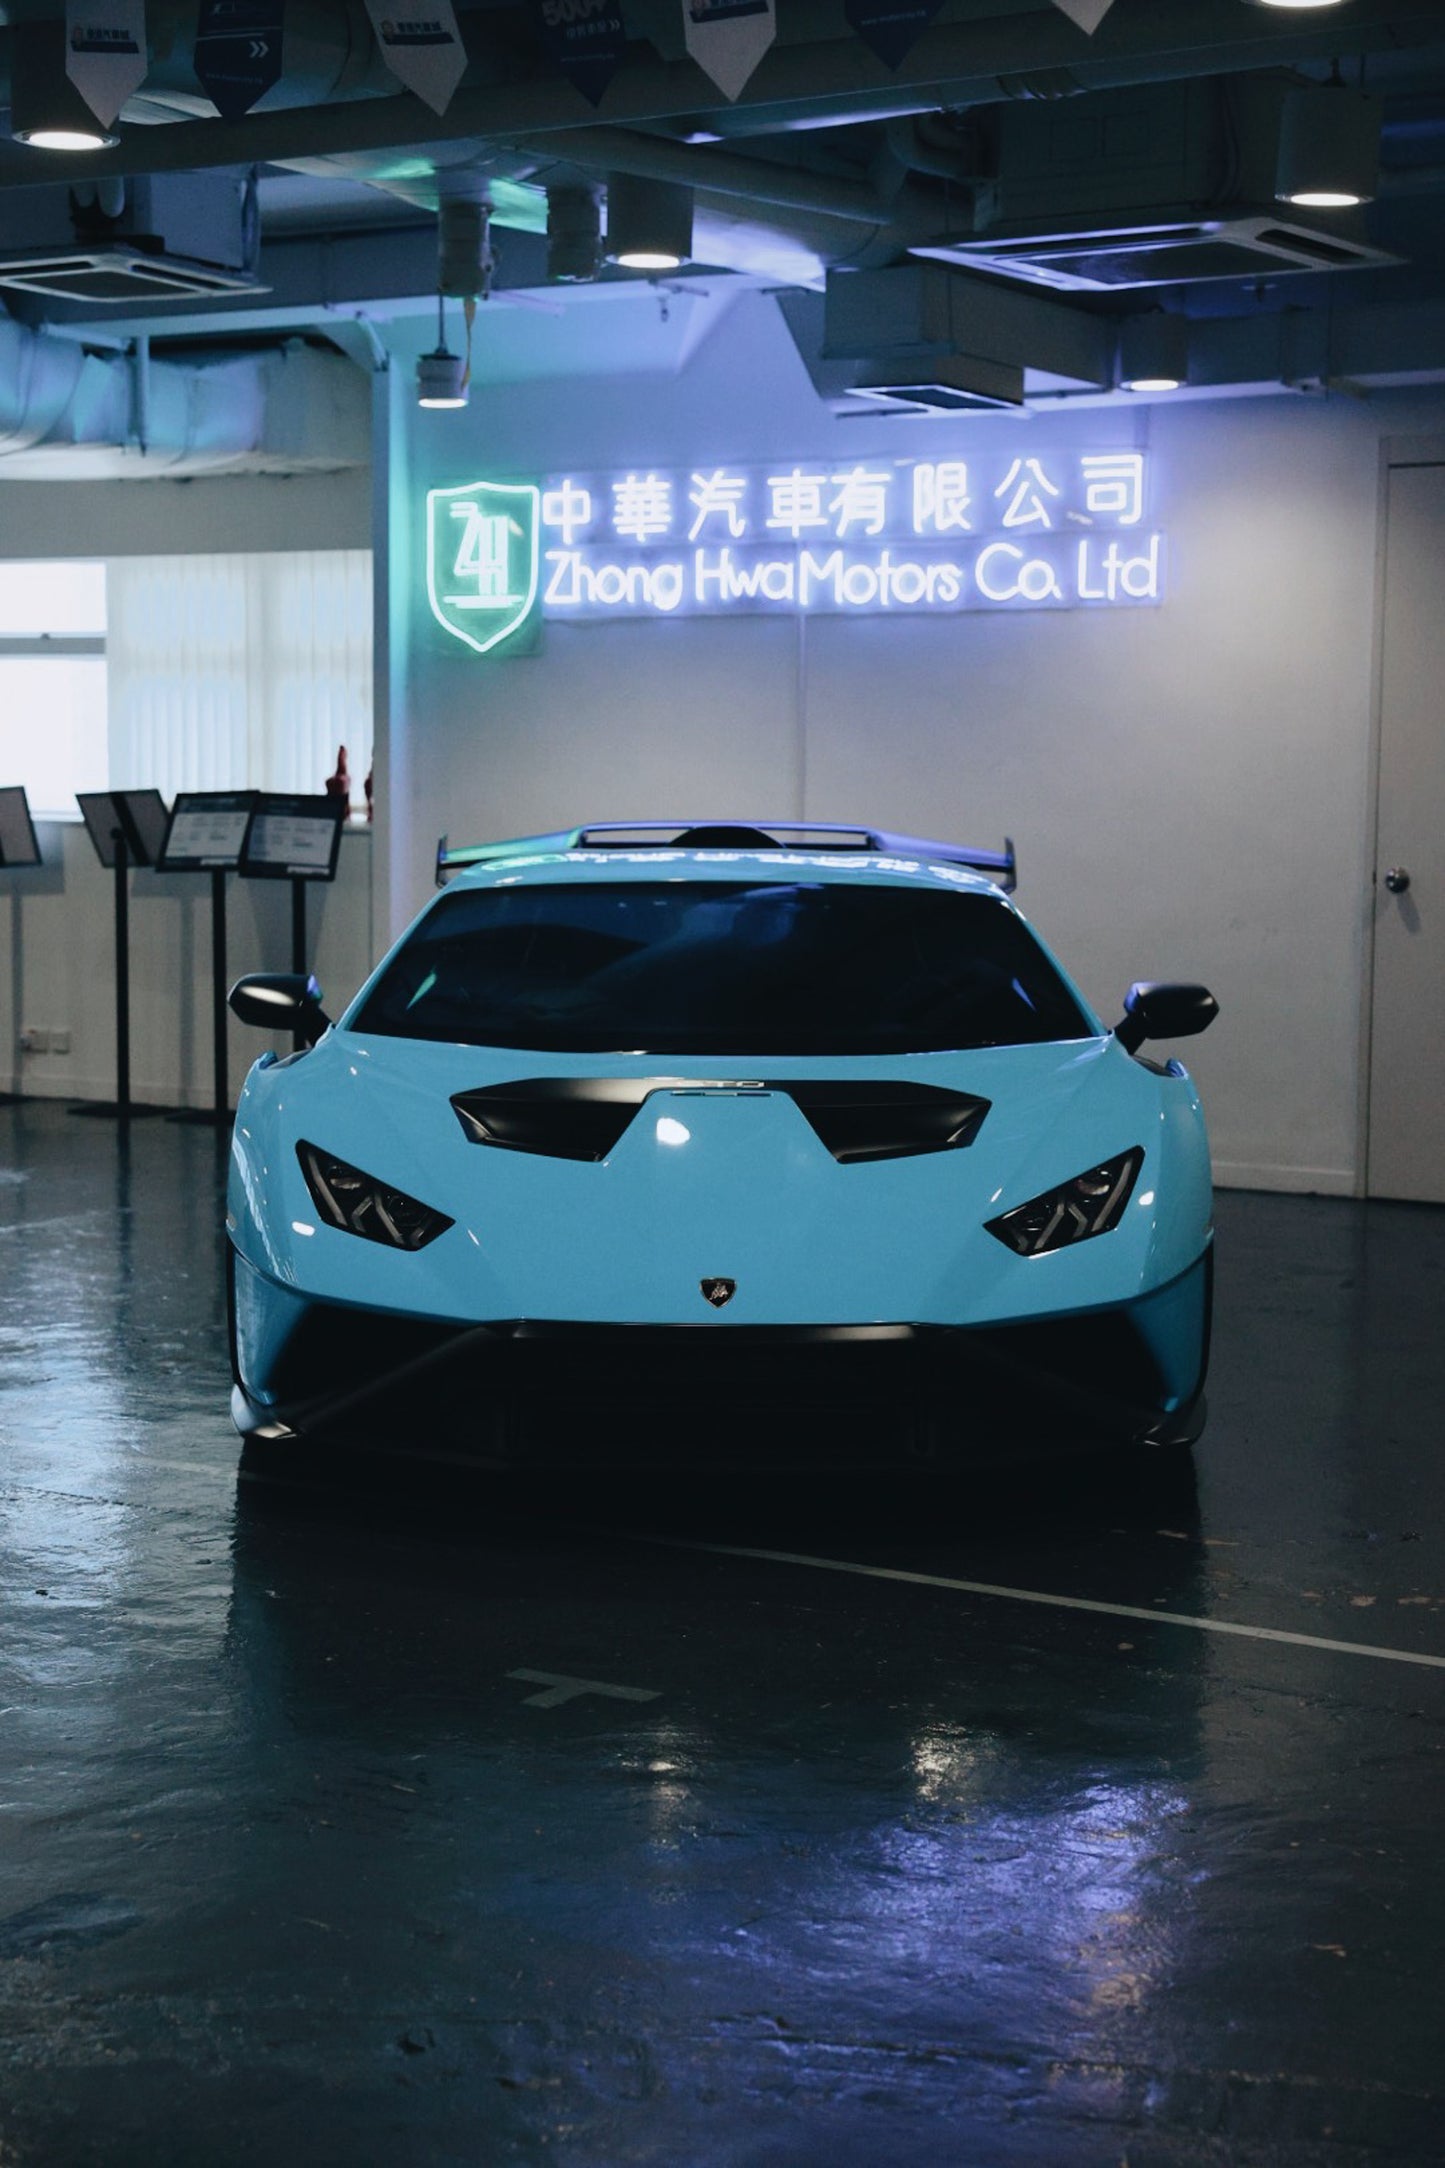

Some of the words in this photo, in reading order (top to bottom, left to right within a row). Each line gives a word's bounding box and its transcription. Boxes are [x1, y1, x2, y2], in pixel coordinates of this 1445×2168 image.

[542, 454, 1143, 545] 中華汽車有限公司
[544, 551, 683, 611] Zhong
[695, 548, 794, 601] Hwa
[799, 549, 959, 605] Motors
[1078, 534, 1160, 601] Ltd
